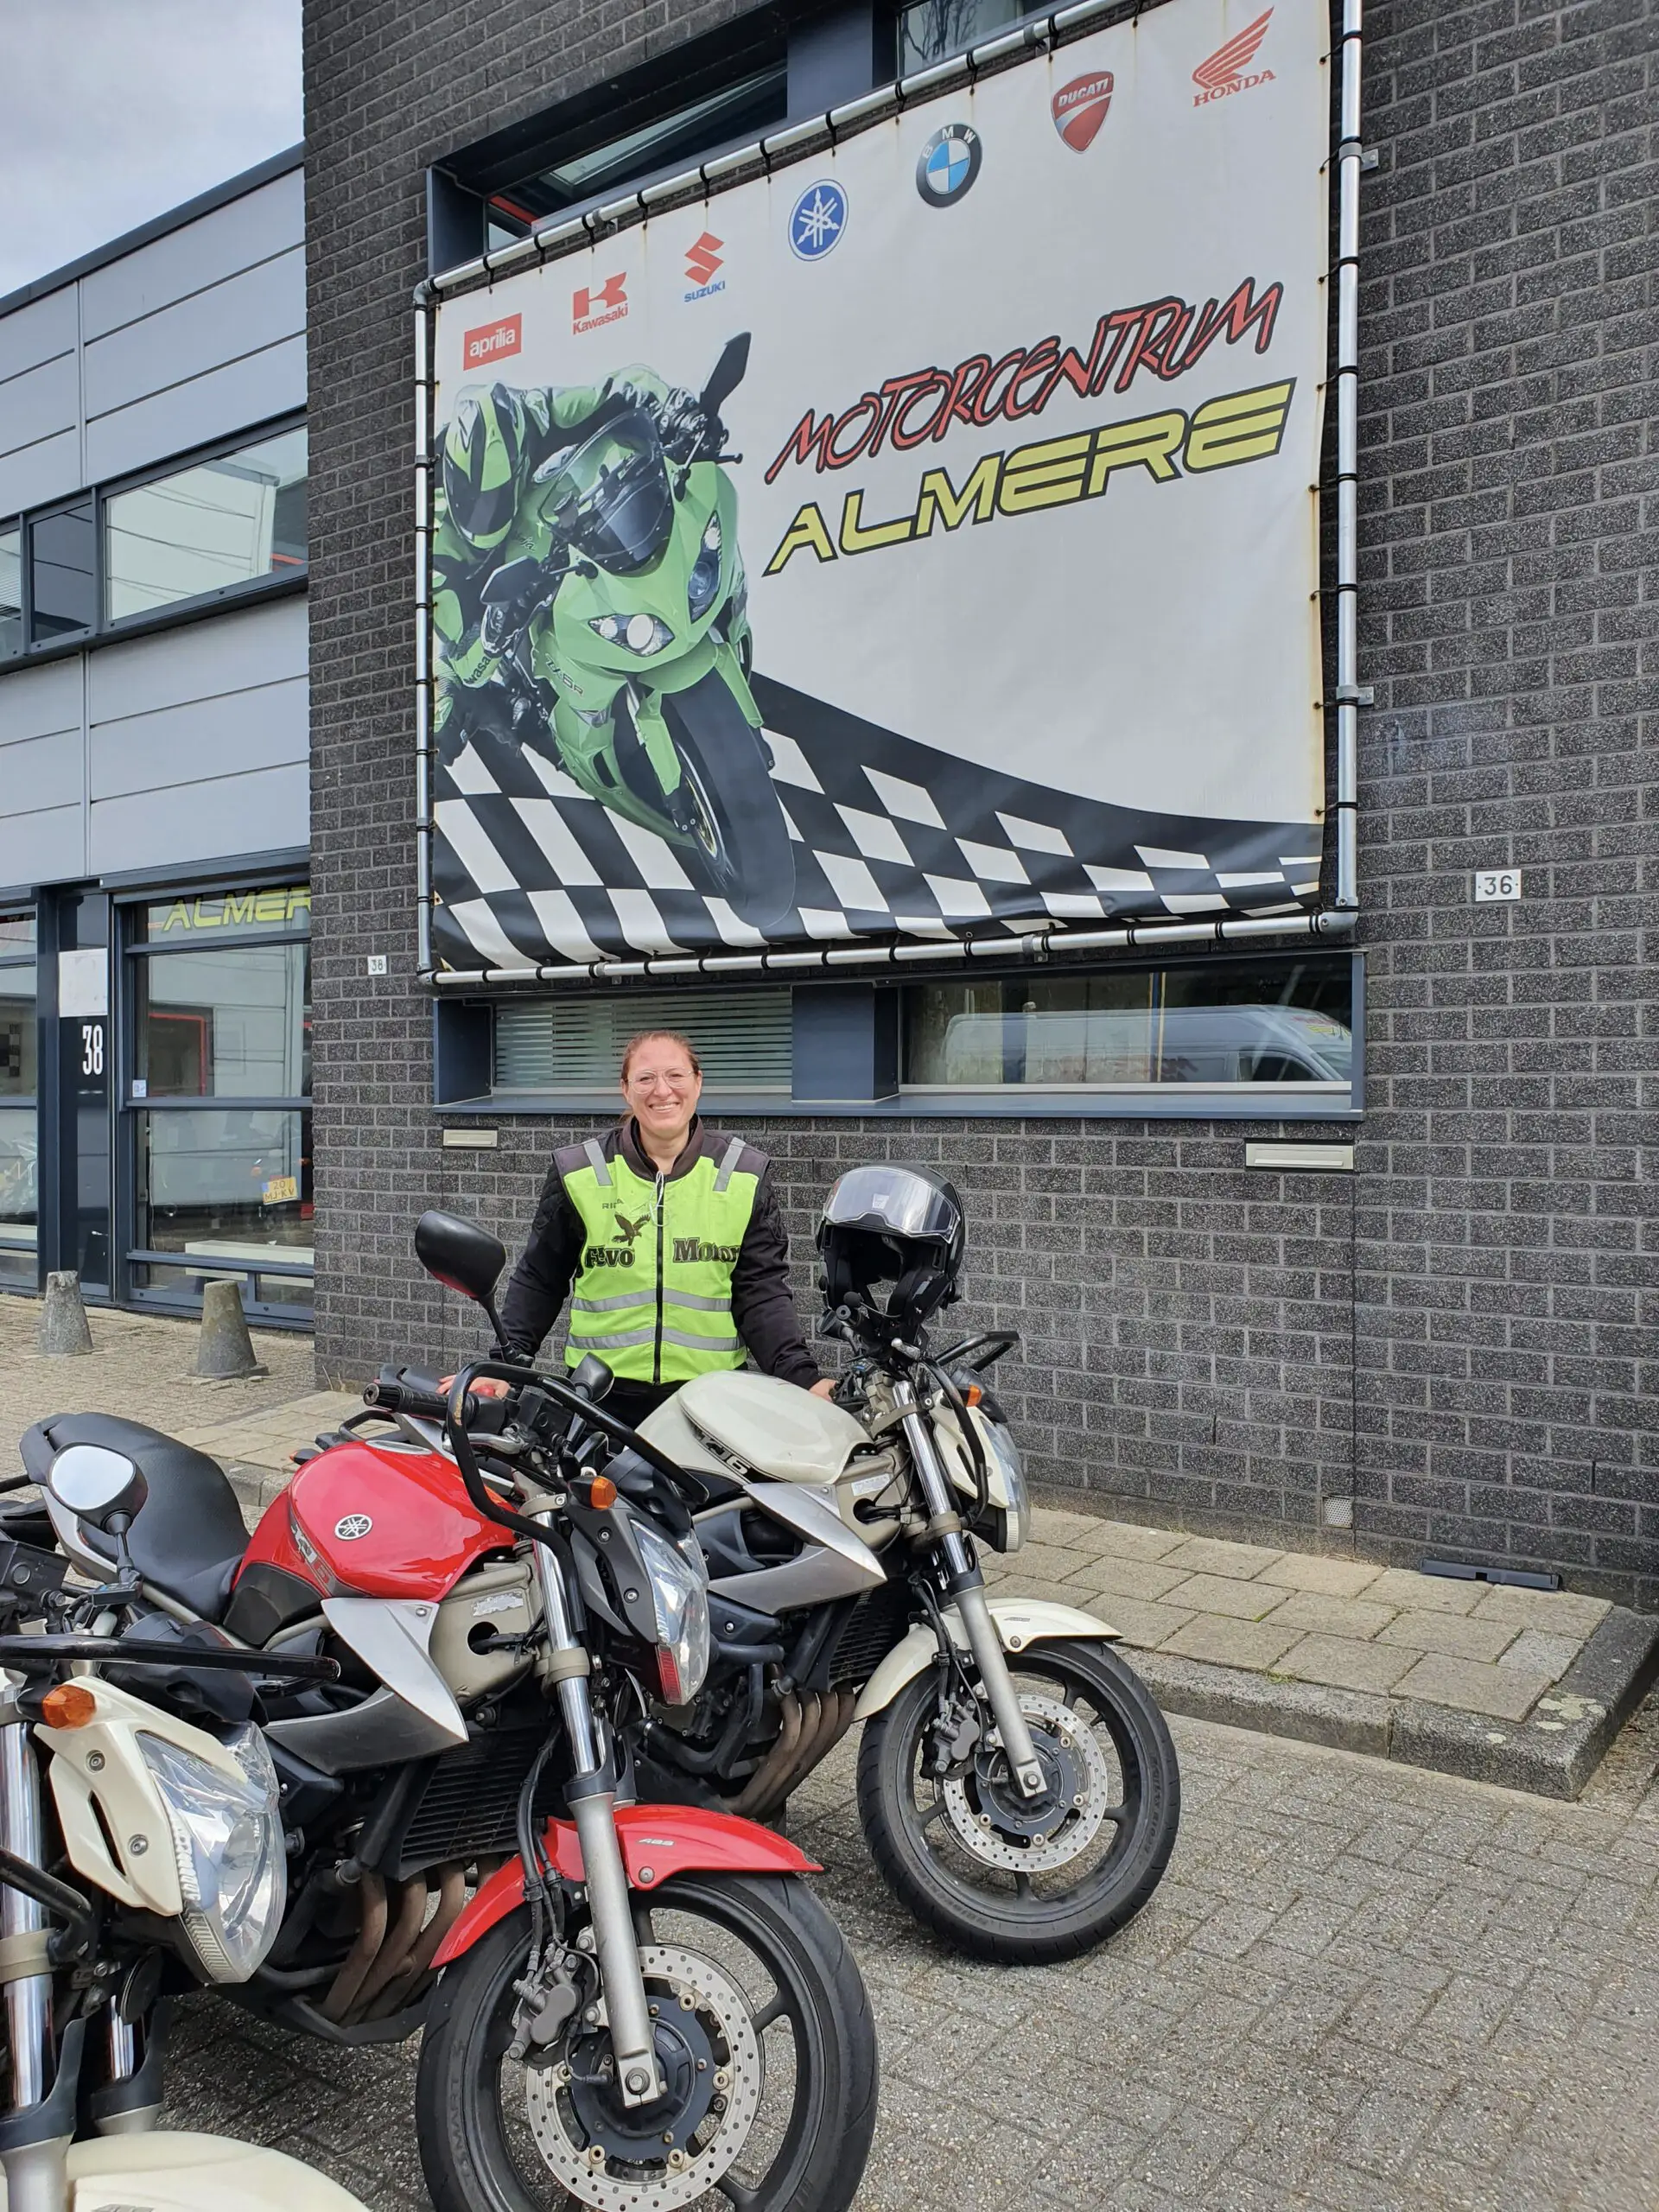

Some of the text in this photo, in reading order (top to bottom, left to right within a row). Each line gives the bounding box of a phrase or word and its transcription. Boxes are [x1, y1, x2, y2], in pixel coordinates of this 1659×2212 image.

[1058, 78, 1109, 107] DUCATI
[1193, 69, 1276, 107] HONDA
[922, 125, 976, 159] BMW
[684, 281, 726, 302] SUZUKI
[573, 302, 628, 335] Kawasaki
[470, 326, 516, 359] aprilia
[764, 276, 1284, 486] MOTORCENTRUM
[761, 377, 1298, 578] ALMERE
[1484, 874, 1513, 896] 36
[371, 958, 384, 972] 38
[82, 1024, 104, 1076] 38
